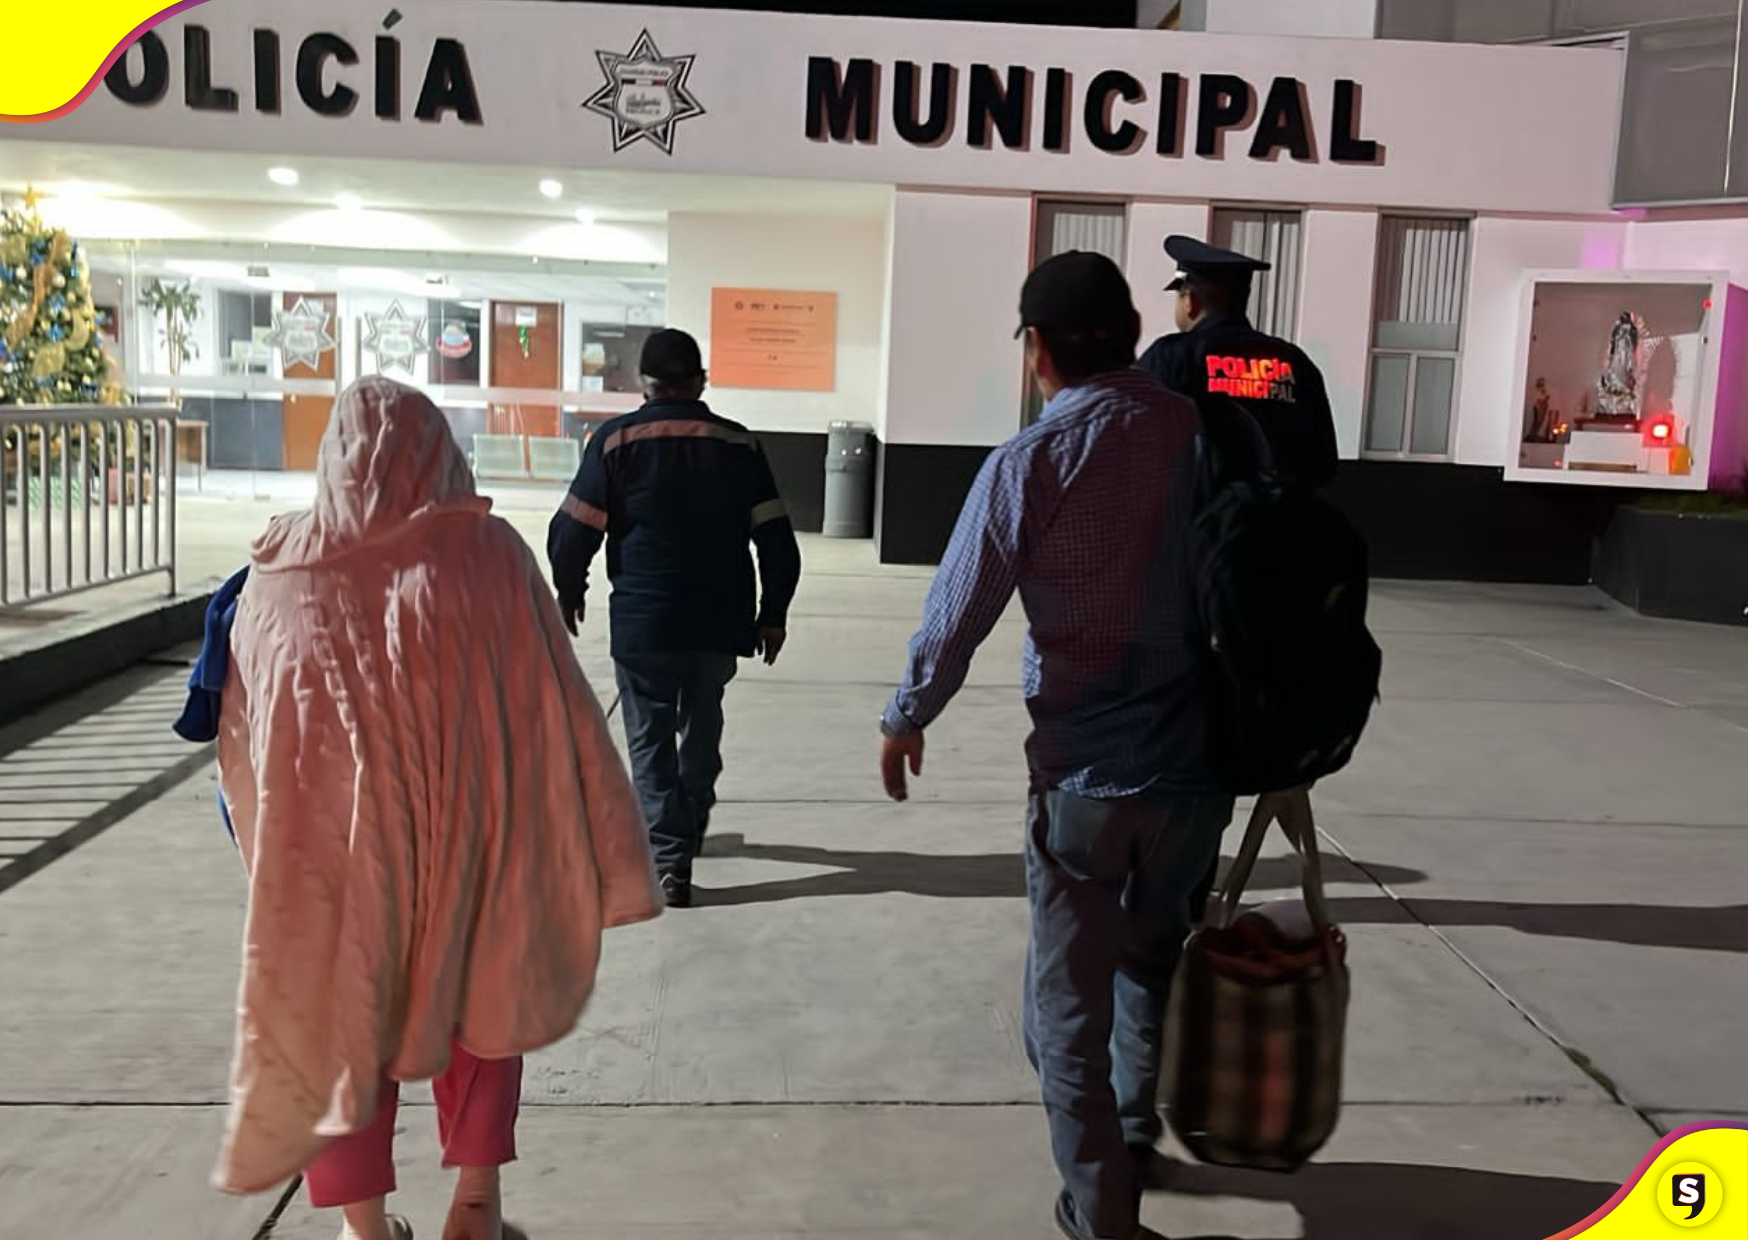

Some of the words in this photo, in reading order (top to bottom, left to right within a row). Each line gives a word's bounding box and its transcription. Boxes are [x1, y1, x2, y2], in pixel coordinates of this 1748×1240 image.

[104, 9, 483, 125] OLICÍA
[804, 56, 1385, 166] MUNICIPAL
[1208, 377, 1296, 403] MUNICIPAL
